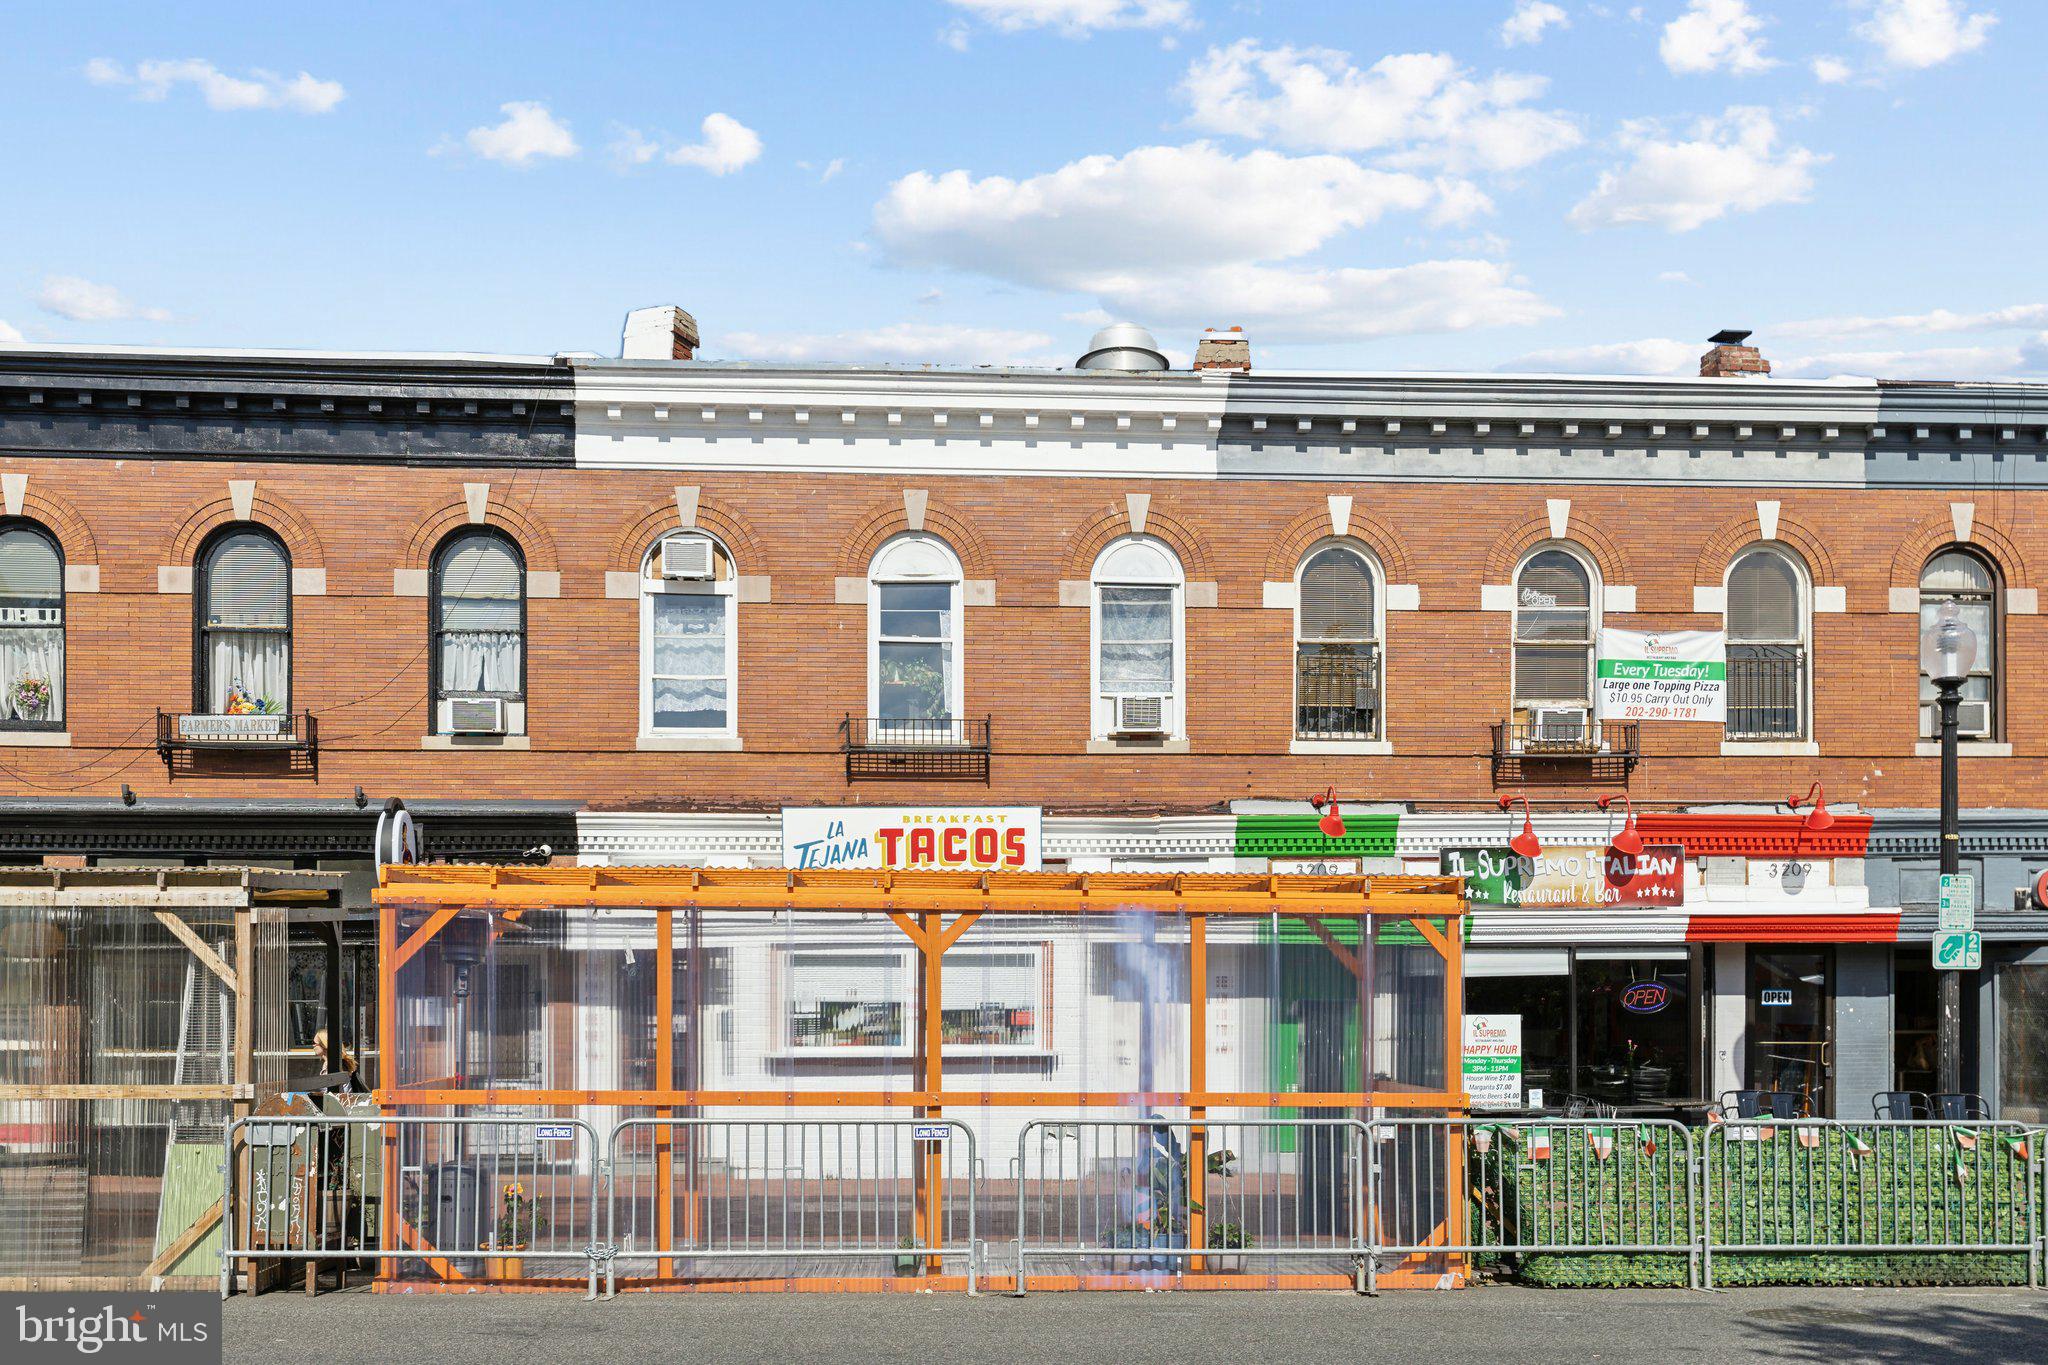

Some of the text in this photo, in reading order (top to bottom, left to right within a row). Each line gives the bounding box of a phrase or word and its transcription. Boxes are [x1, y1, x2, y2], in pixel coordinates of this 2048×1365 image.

[1650, 646, 1679, 654] SUPREMO
[1613, 662, 1710, 680] Every Tuesday!
[1603, 679, 1720, 693] Large one Topping Pizza
[1609, 692, 1714, 707] $10.95 Carry Out Only
[1625, 706, 1698, 718] 202-290-1781
[234, 719, 278, 732] MARKET
[902, 814, 1008, 824] BREAKFAST
[826, 820, 845, 840] LA
[793, 837, 869, 870] TEJANA
[875, 827, 1026, 870] TACOS
[1448, 849, 1677, 880] IL SUPREMO ITALIAN
[1768, 863, 1812, 879] 3209
[1503, 878, 1622, 904] Restaurant & Bar
[1968, 933, 1978, 949] 2
[1623, 987, 1668, 1007] OPEN
[1763, 991, 1790, 1004] OPEN
[1479, 1029, 1507, 1037] SUPREMO
[1463, 1045, 1518, 1055] HAPPY HOUR
[1464, 1057, 1488, 1065] Monday
[1490, 1057, 1518, 1065] Thursday
[1468, 1084, 1495, 1092] Margarita
[1503, 1092, 1520, 1100] $4.00
